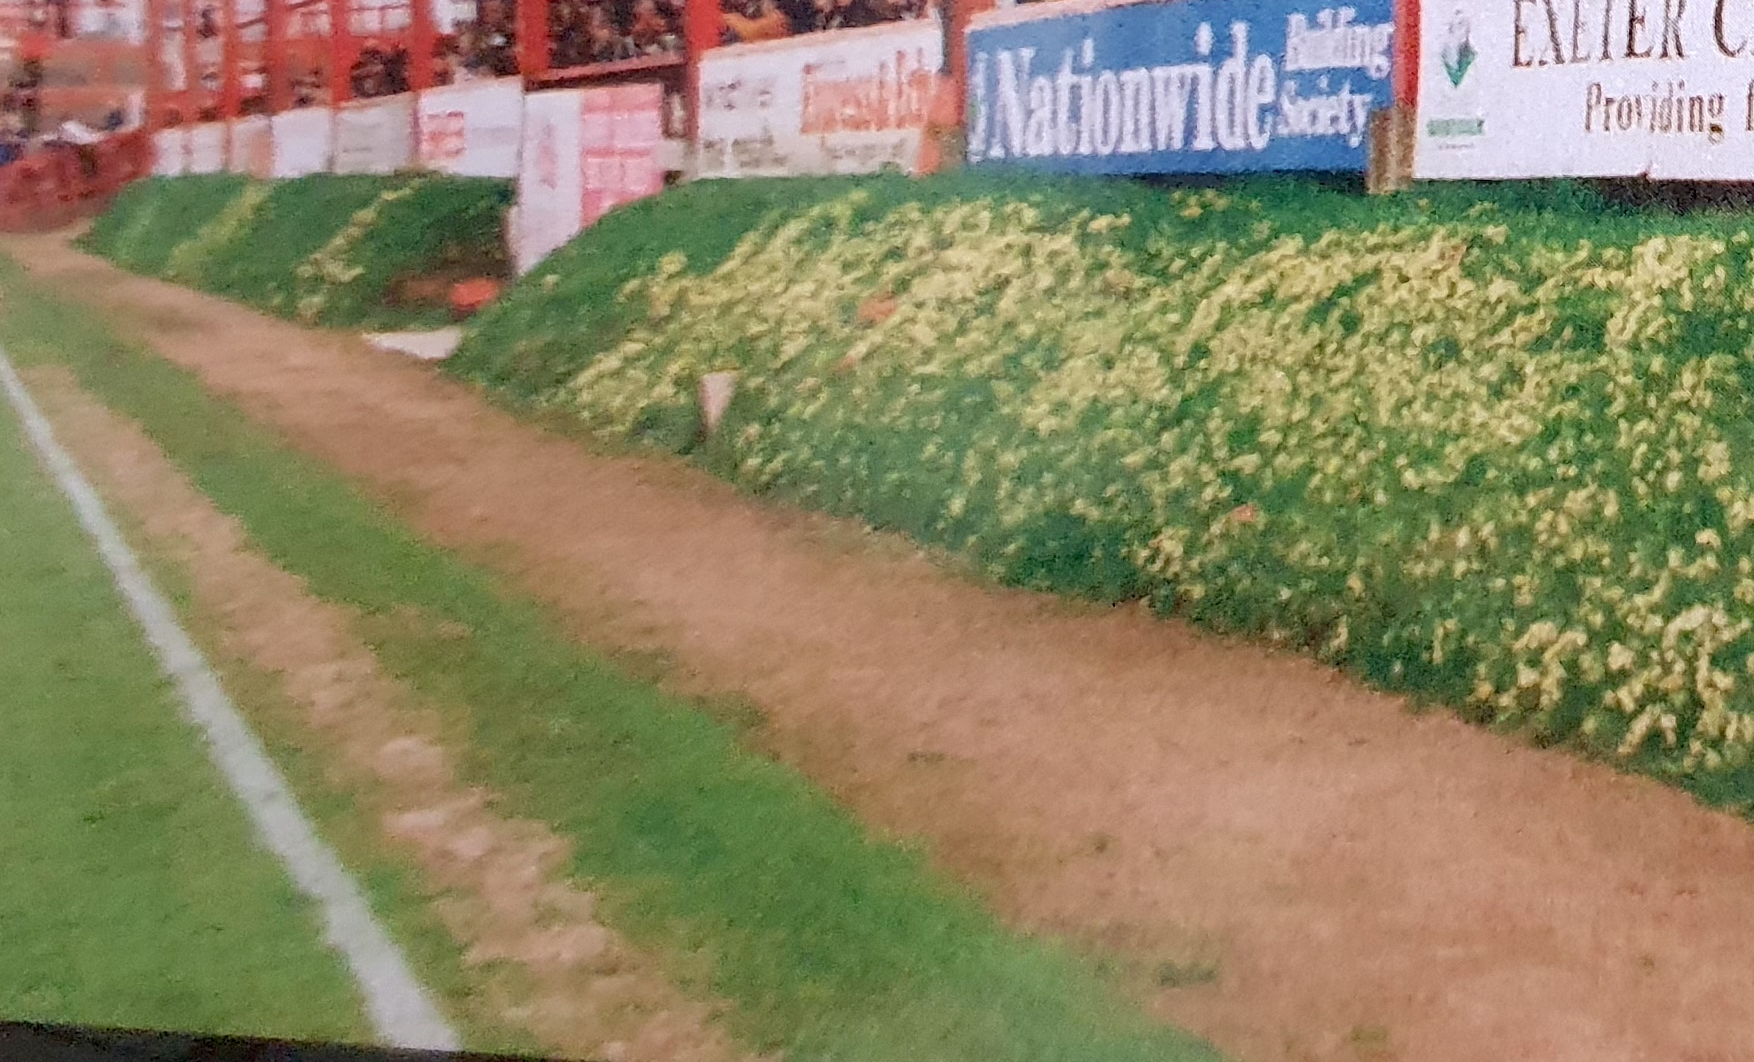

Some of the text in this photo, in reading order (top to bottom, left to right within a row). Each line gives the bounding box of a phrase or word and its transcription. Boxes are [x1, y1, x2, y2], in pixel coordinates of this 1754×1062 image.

[988, 21, 1276, 159] Nationwide
[1278, 73, 1373, 149] Society
[1584, 75, 1726, 144] Providing
